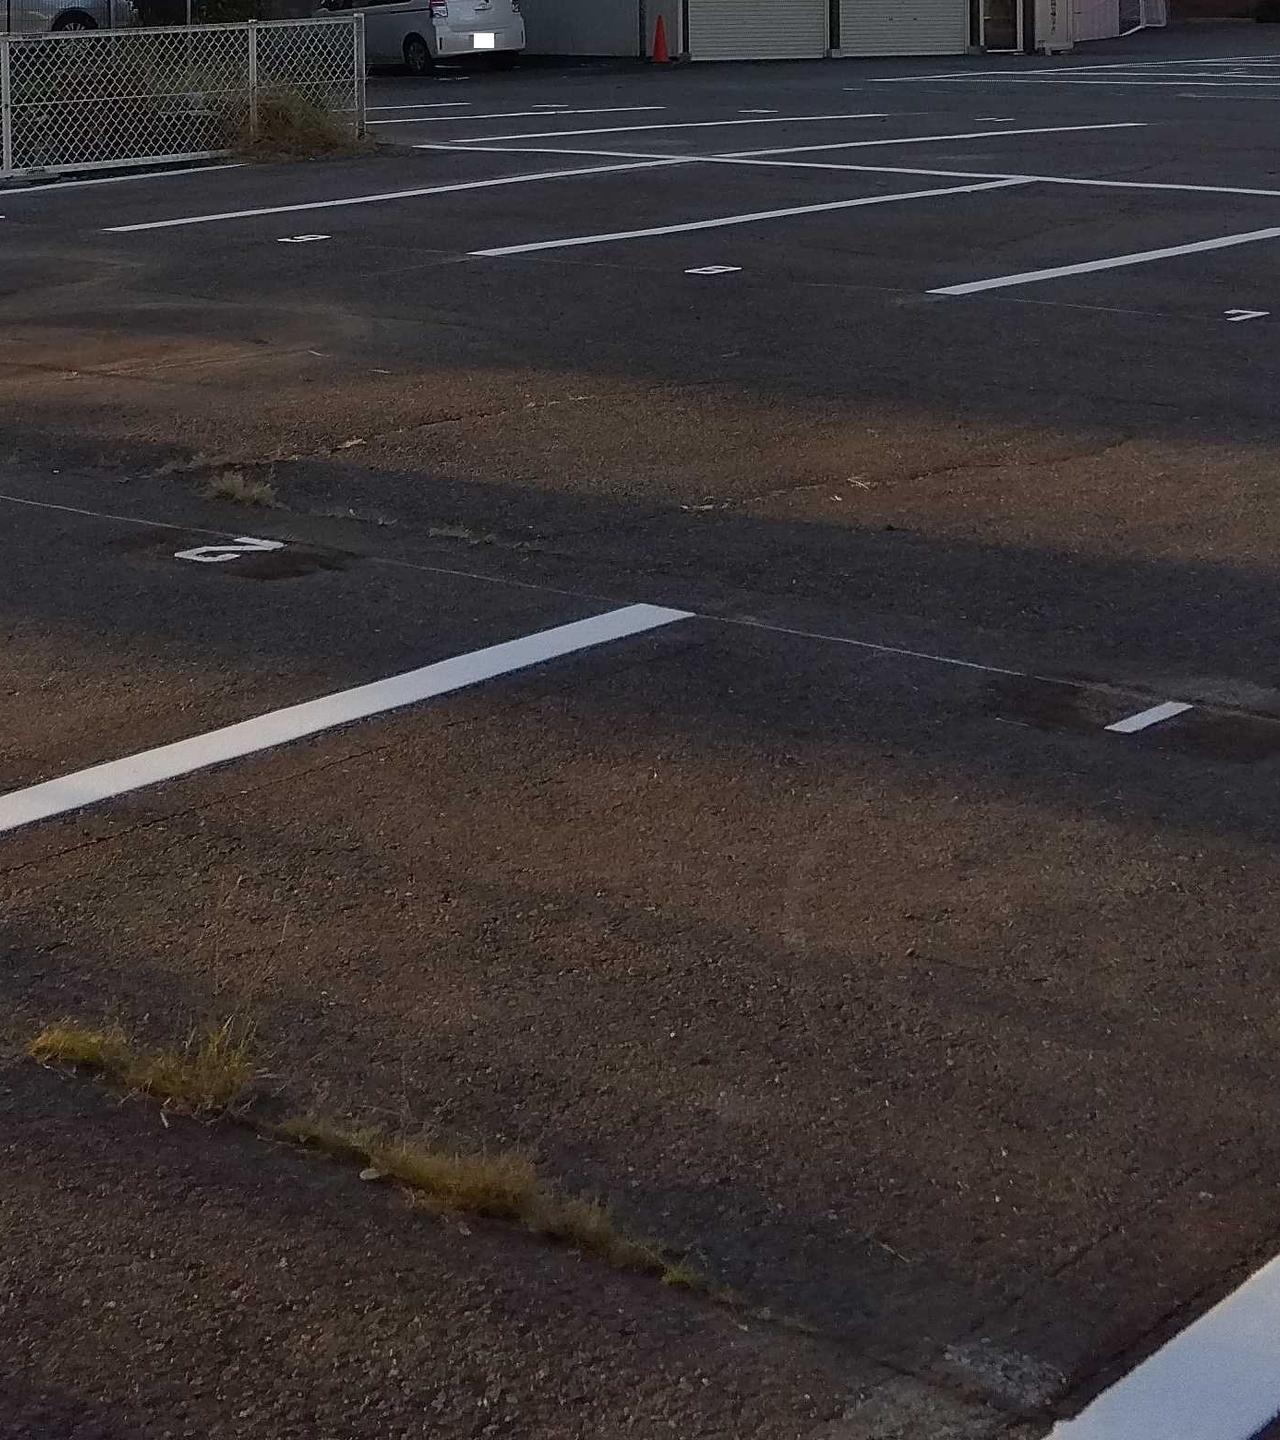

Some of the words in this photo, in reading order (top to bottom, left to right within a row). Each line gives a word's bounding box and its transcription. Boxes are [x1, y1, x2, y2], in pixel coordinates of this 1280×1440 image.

[276, 234, 332, 243] 9
[684, 265, 742, 275] 8
[1223, 309, 1270, 321] 7
[174, 536, 288, 563] 2
